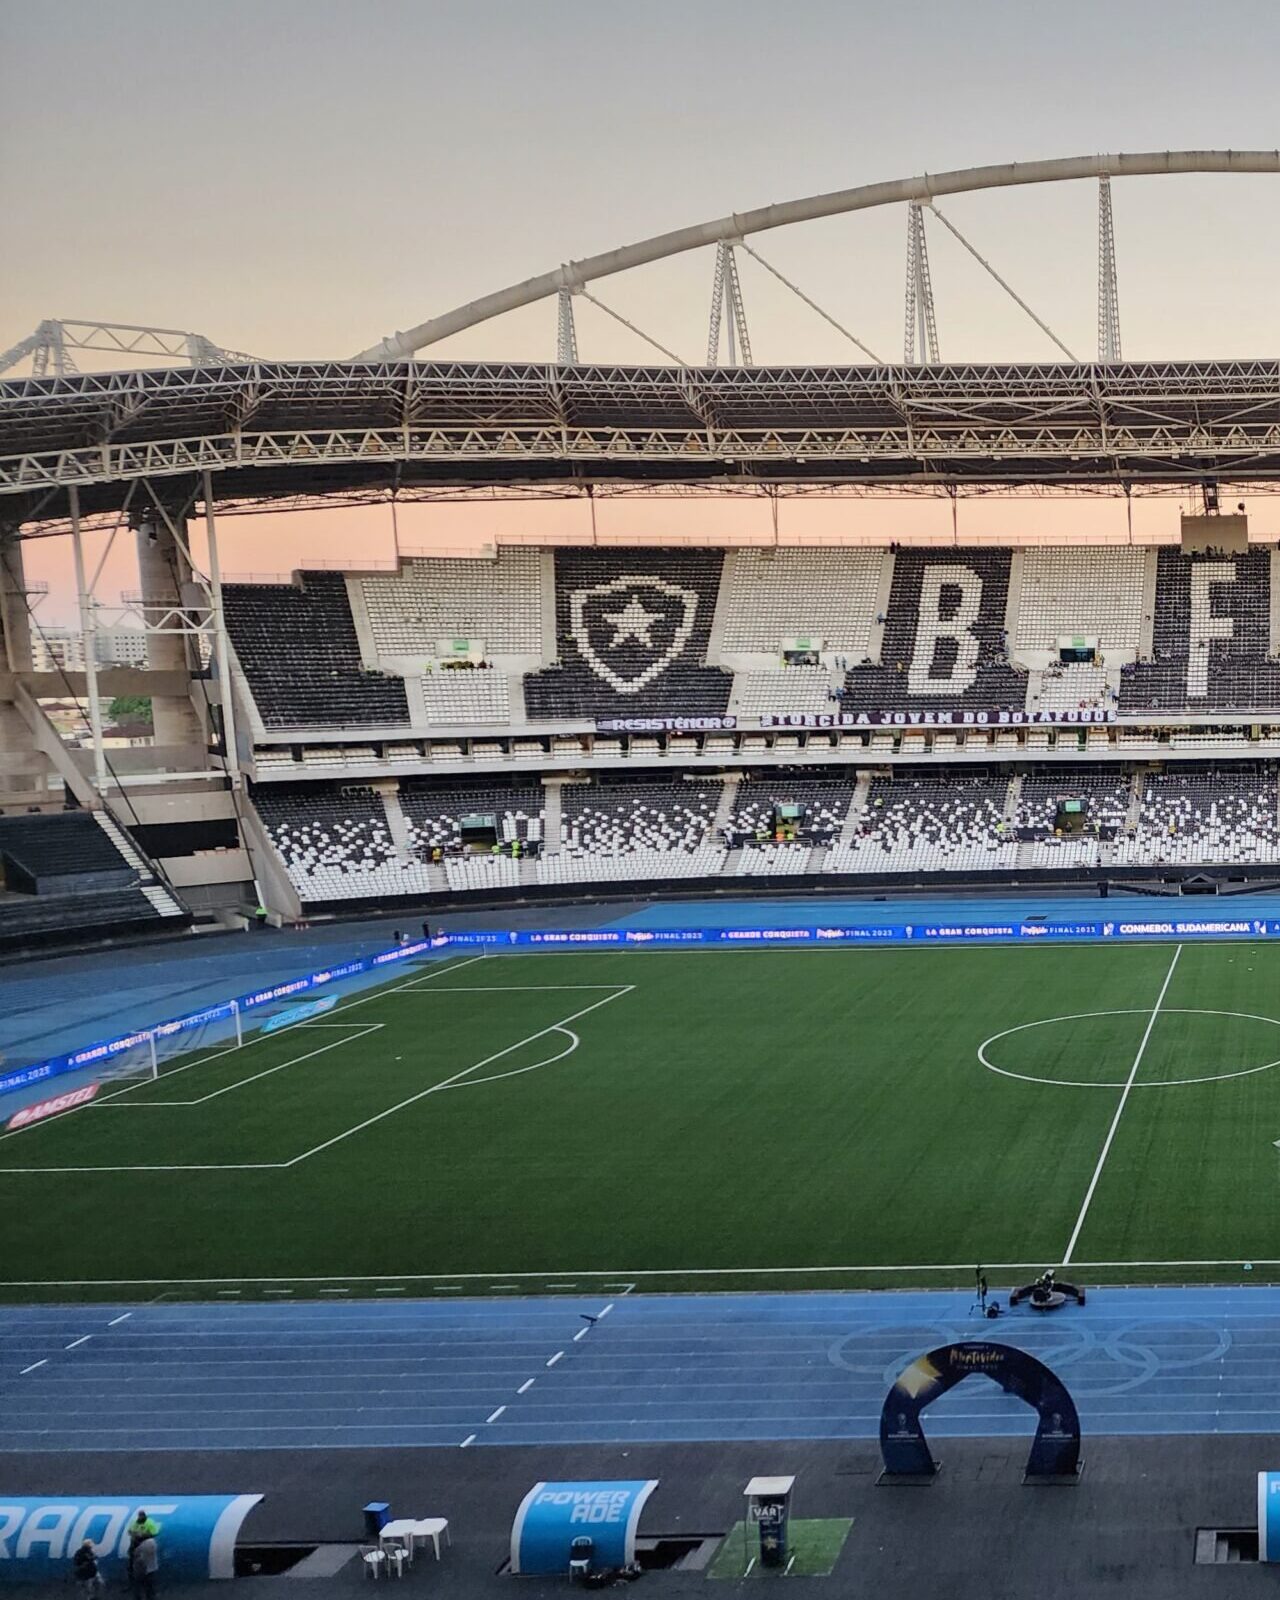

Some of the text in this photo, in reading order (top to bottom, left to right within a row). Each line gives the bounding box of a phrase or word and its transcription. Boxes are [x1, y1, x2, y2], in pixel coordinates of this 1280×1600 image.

[908, 564, 983, 695] B
[1186, 561, 1236, 696] F
[777, 713, 871, 727] TORCIDA
[881, 711, 953, 724] JOVEM
[963, 711, 989, 723] DO
[926, 928, 938, 936] LA
[1119, 923, 1249, 933] CONMEBOL SUDAMERICANA
[531, 934, 542, 942] LA
[246, 997, 255, 1006] LA
[30, 1086, 95, 1117] AMSTEL
[535, 1489, 631, 1507] POWER
[570, 1503, 624, 1524] ADE
[753, 1506, 777, 1517] VAR
